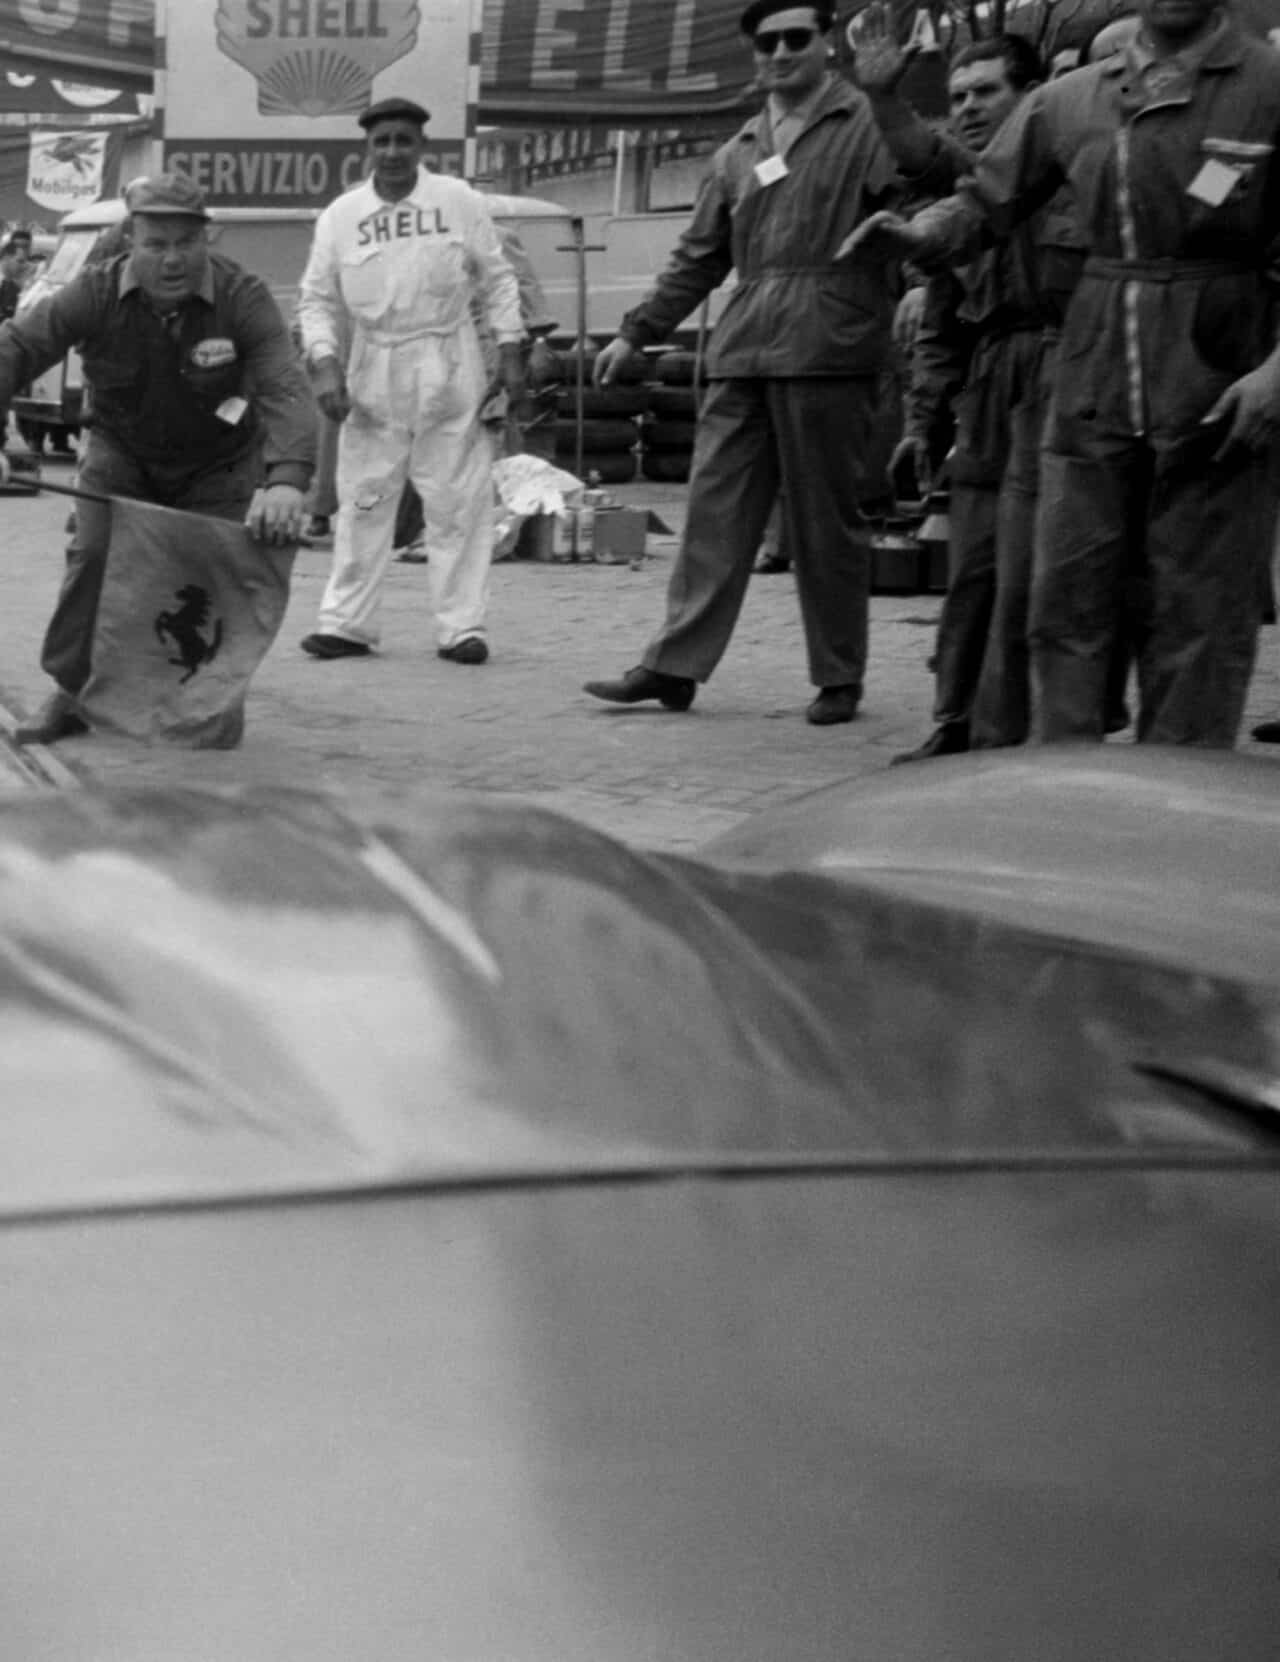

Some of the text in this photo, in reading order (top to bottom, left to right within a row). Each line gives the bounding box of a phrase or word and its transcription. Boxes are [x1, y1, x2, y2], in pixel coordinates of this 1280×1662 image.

[246, 0, 388, 38] SHELL
[171, 152, 328, 194] SERVIZIO
[358, 208, 449, 246] SHELL
